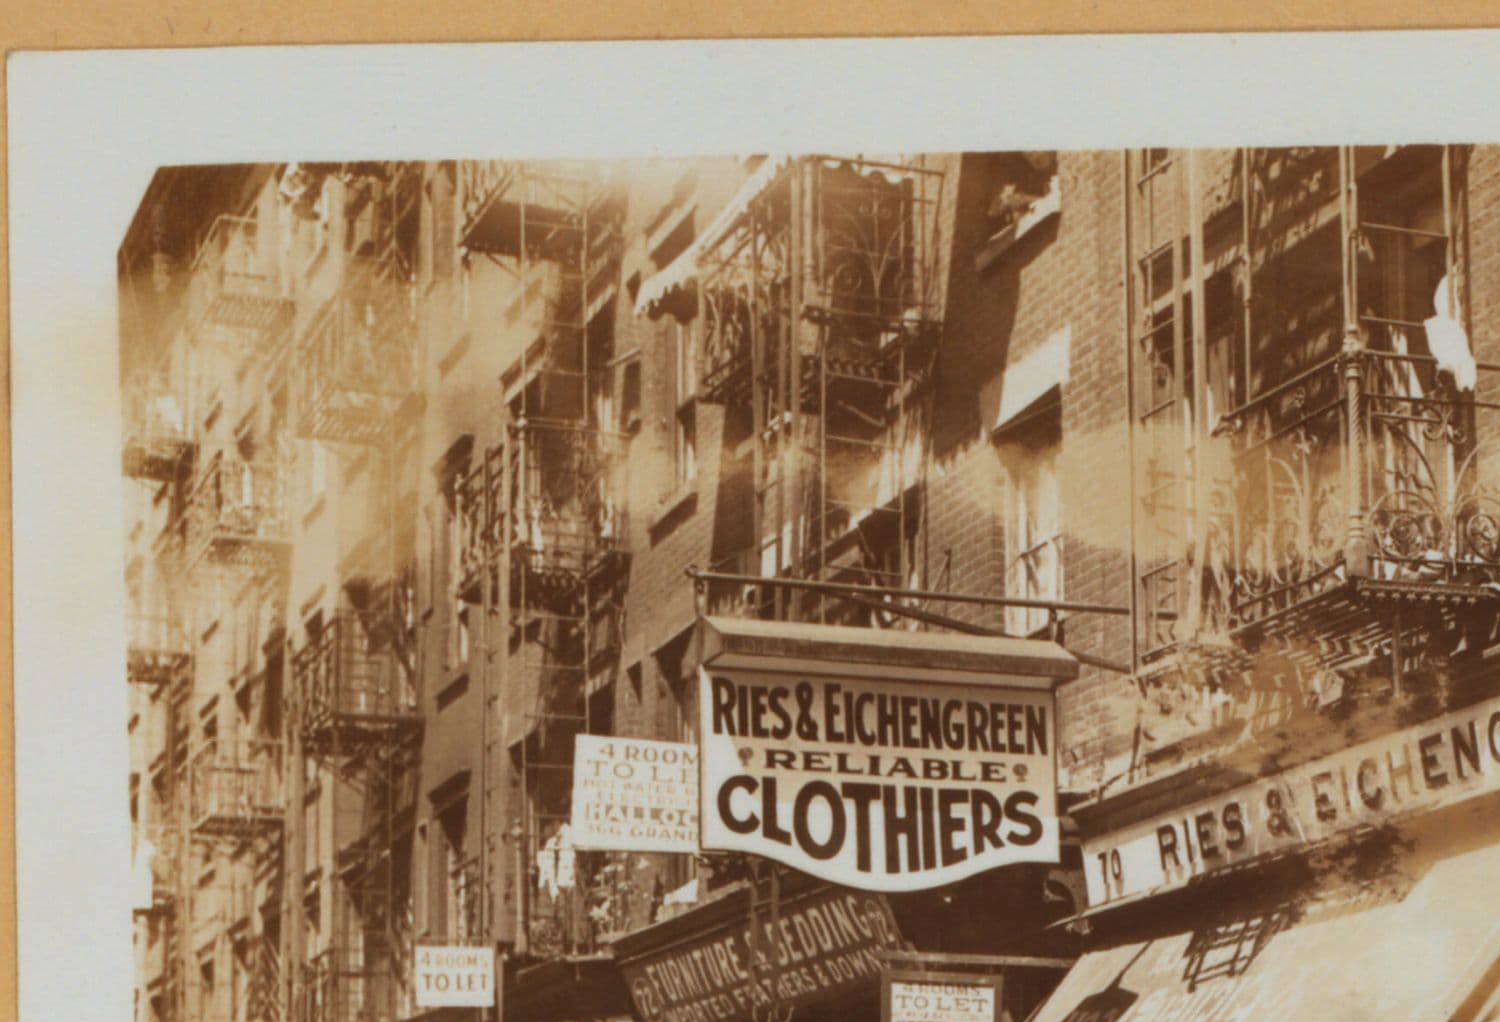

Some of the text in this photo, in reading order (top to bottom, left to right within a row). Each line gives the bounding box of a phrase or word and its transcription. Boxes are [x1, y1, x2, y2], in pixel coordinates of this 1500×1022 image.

[712, 676, 1048, 756] RIES & EICHENGREEN
[599, 743, 698, 766] 4 ROOM
[764, 747, 1007, 783] RELIABLE
[586, 759, 698, 784] TO LE
[584, 801, 698, 828] HALLOC
[716, 774, 1044, 875] CLOTHIERS
[1097, 848, 1123, 885] 70
[1156, 802, 1246, 872] RIES
[1265, 787, 1292, 838] &
[420, 973, 490, 993] TO LET
[645, 936, 749, 1006] FURNITURE
[895, 994, 989, 1013] TO LET
